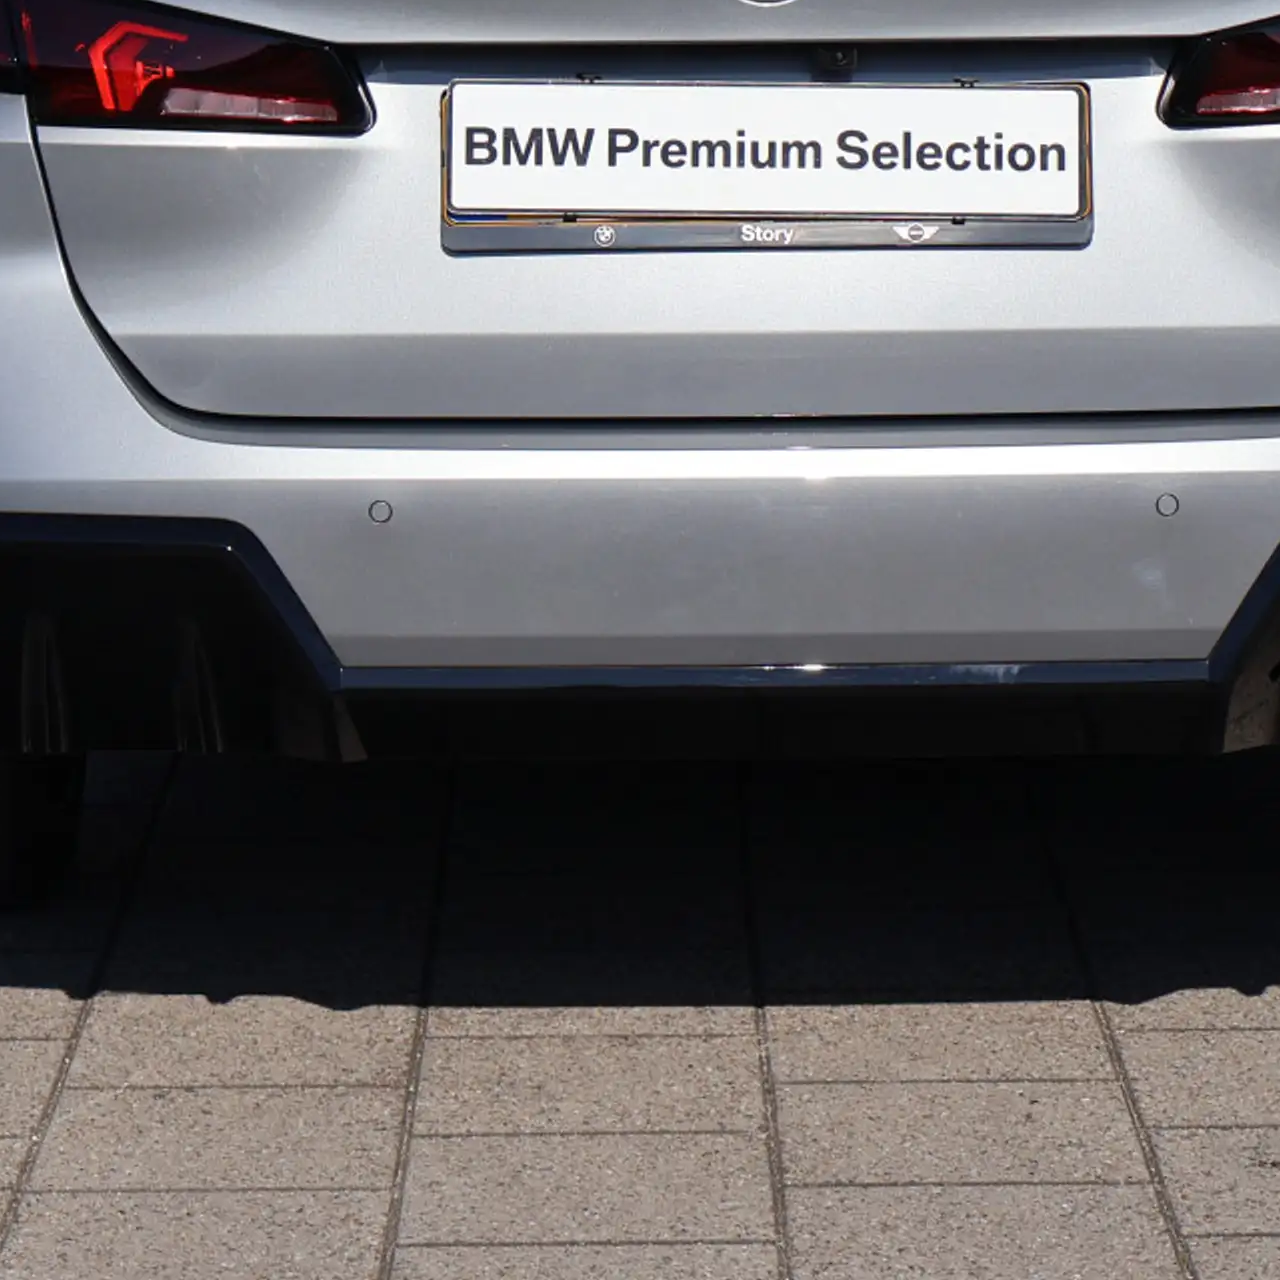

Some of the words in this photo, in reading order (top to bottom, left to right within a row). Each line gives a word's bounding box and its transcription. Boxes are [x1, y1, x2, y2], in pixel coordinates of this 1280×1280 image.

[463, 127, 595, 167] BMW
[607, 128, 822, 170] Premium
[835, 129, 1067, 172] Selection
[740, 224, 794, 246] Story
